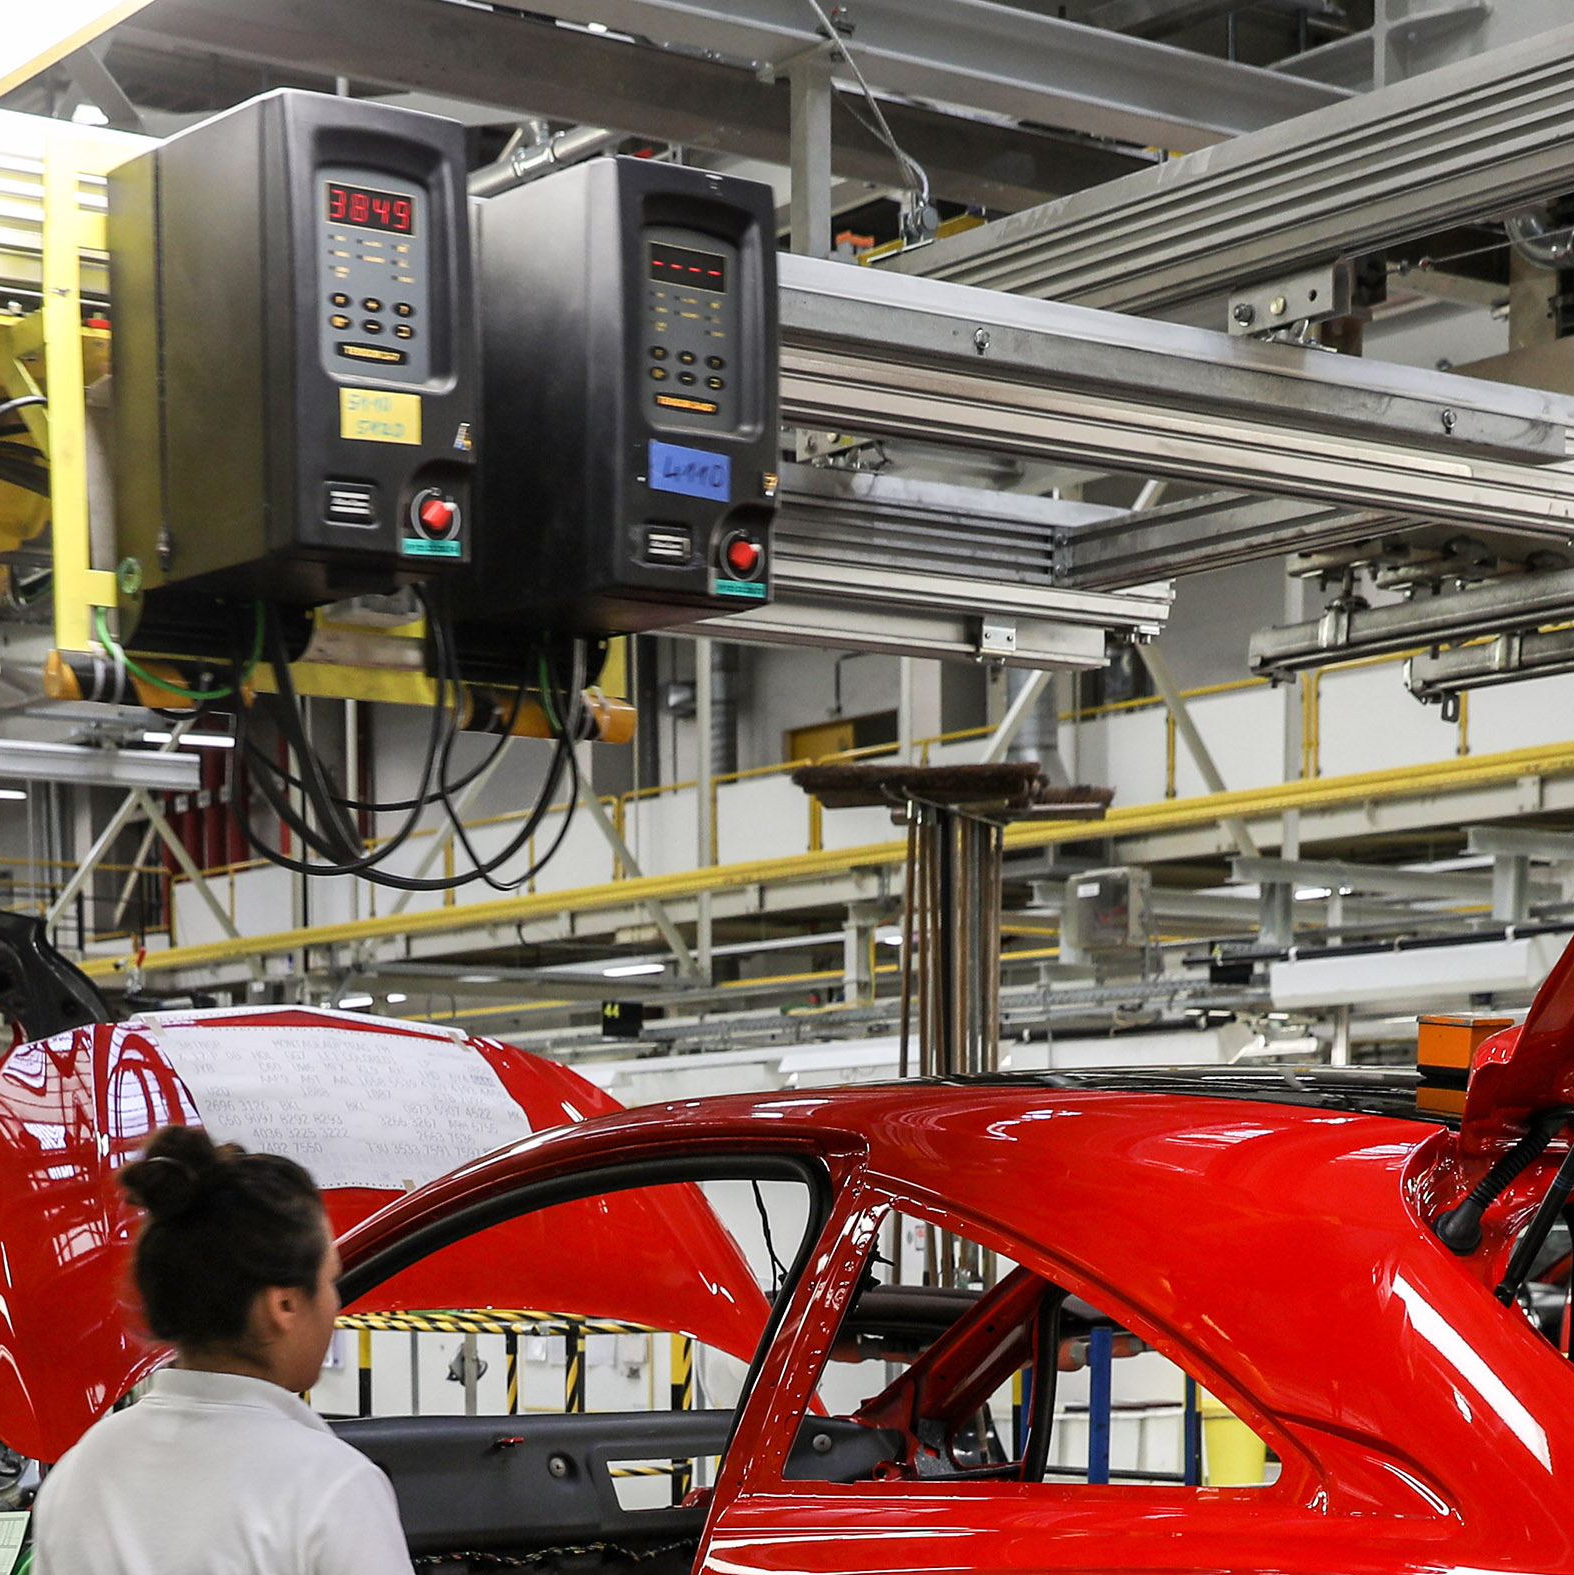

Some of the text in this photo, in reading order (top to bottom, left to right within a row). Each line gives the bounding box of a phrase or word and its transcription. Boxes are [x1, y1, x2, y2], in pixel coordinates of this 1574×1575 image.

[329, 189, 411, 229] 3849
[206, 1100, 236, 1112] 2696
[252, 1128, 283, 1138] 4036
[288, 1127, 317, 1138] 3225
